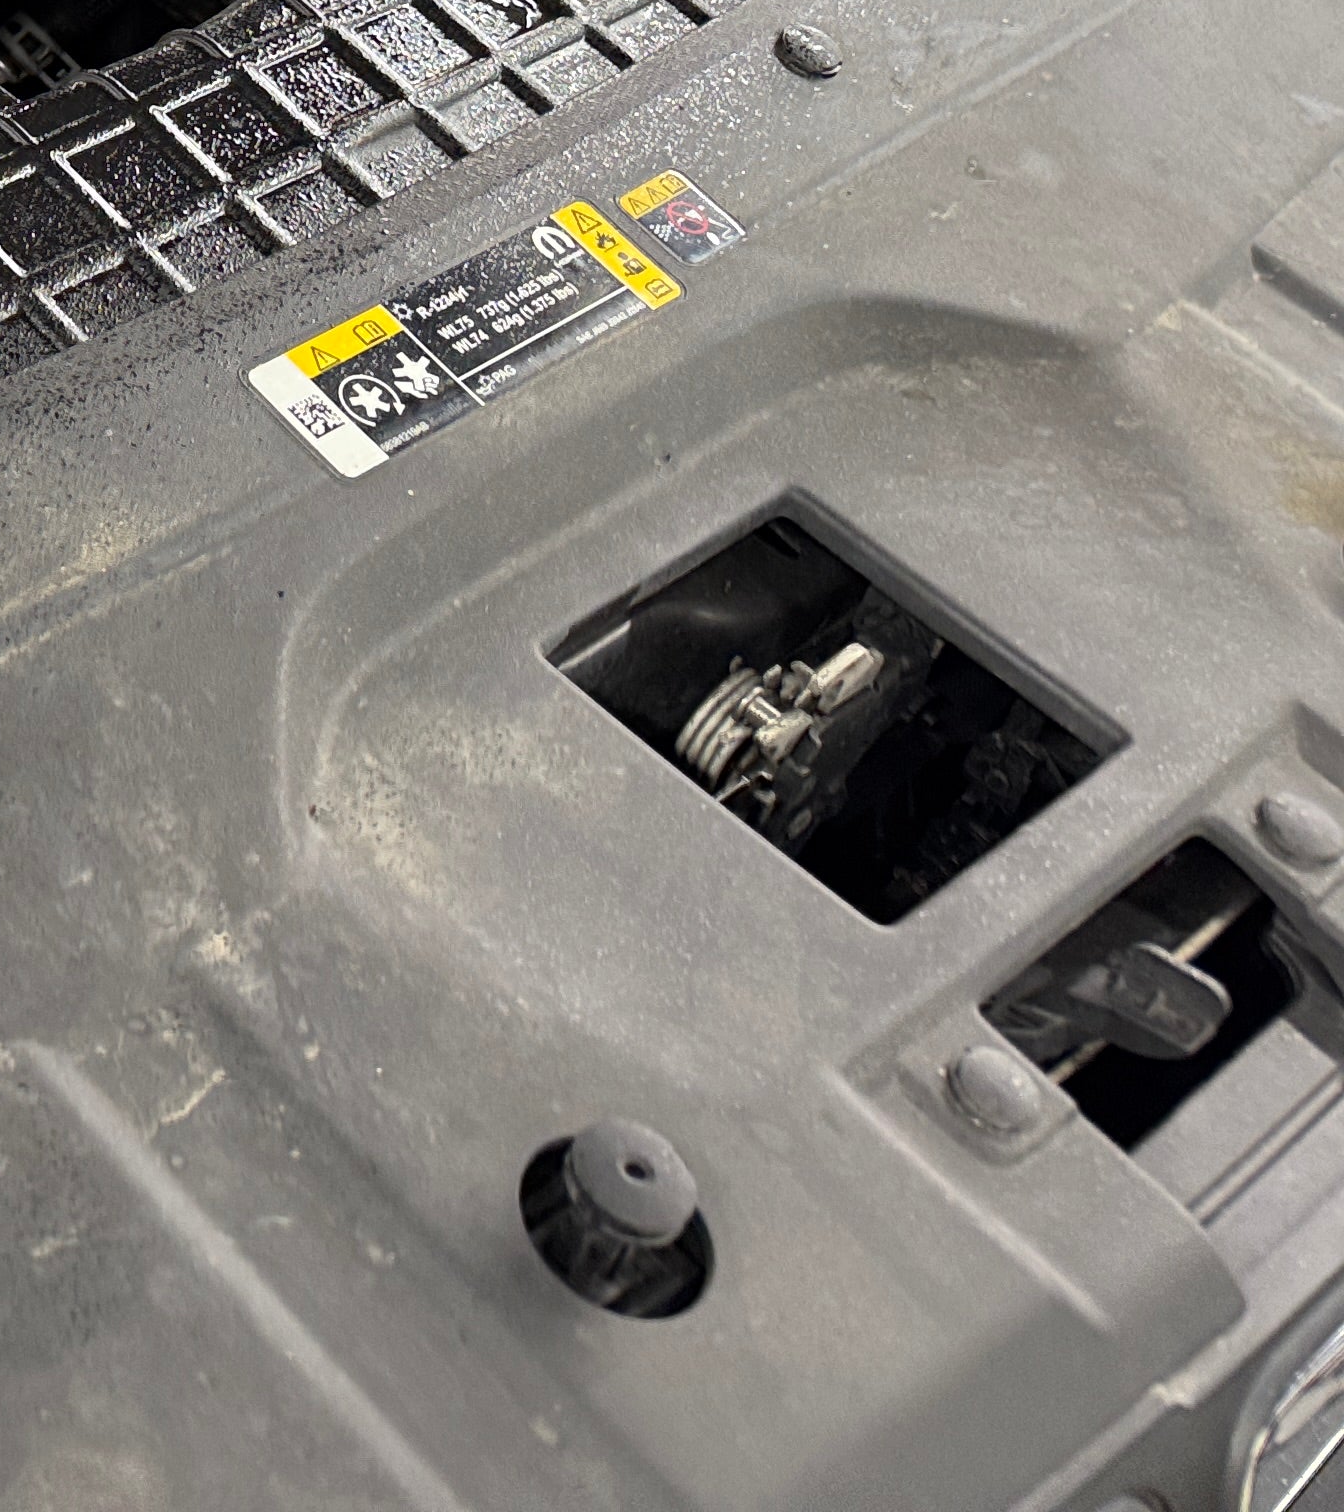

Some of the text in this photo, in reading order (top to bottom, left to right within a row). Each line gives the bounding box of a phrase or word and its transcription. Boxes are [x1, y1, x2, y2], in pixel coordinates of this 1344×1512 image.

[437, 318, 475, 340] WL75
[476, 295, 510, 321] 737g
[452, 332, 489, 355] WL74
[492, 309, 525, 334] 624g
[491, 363, 517, 385] PAG
